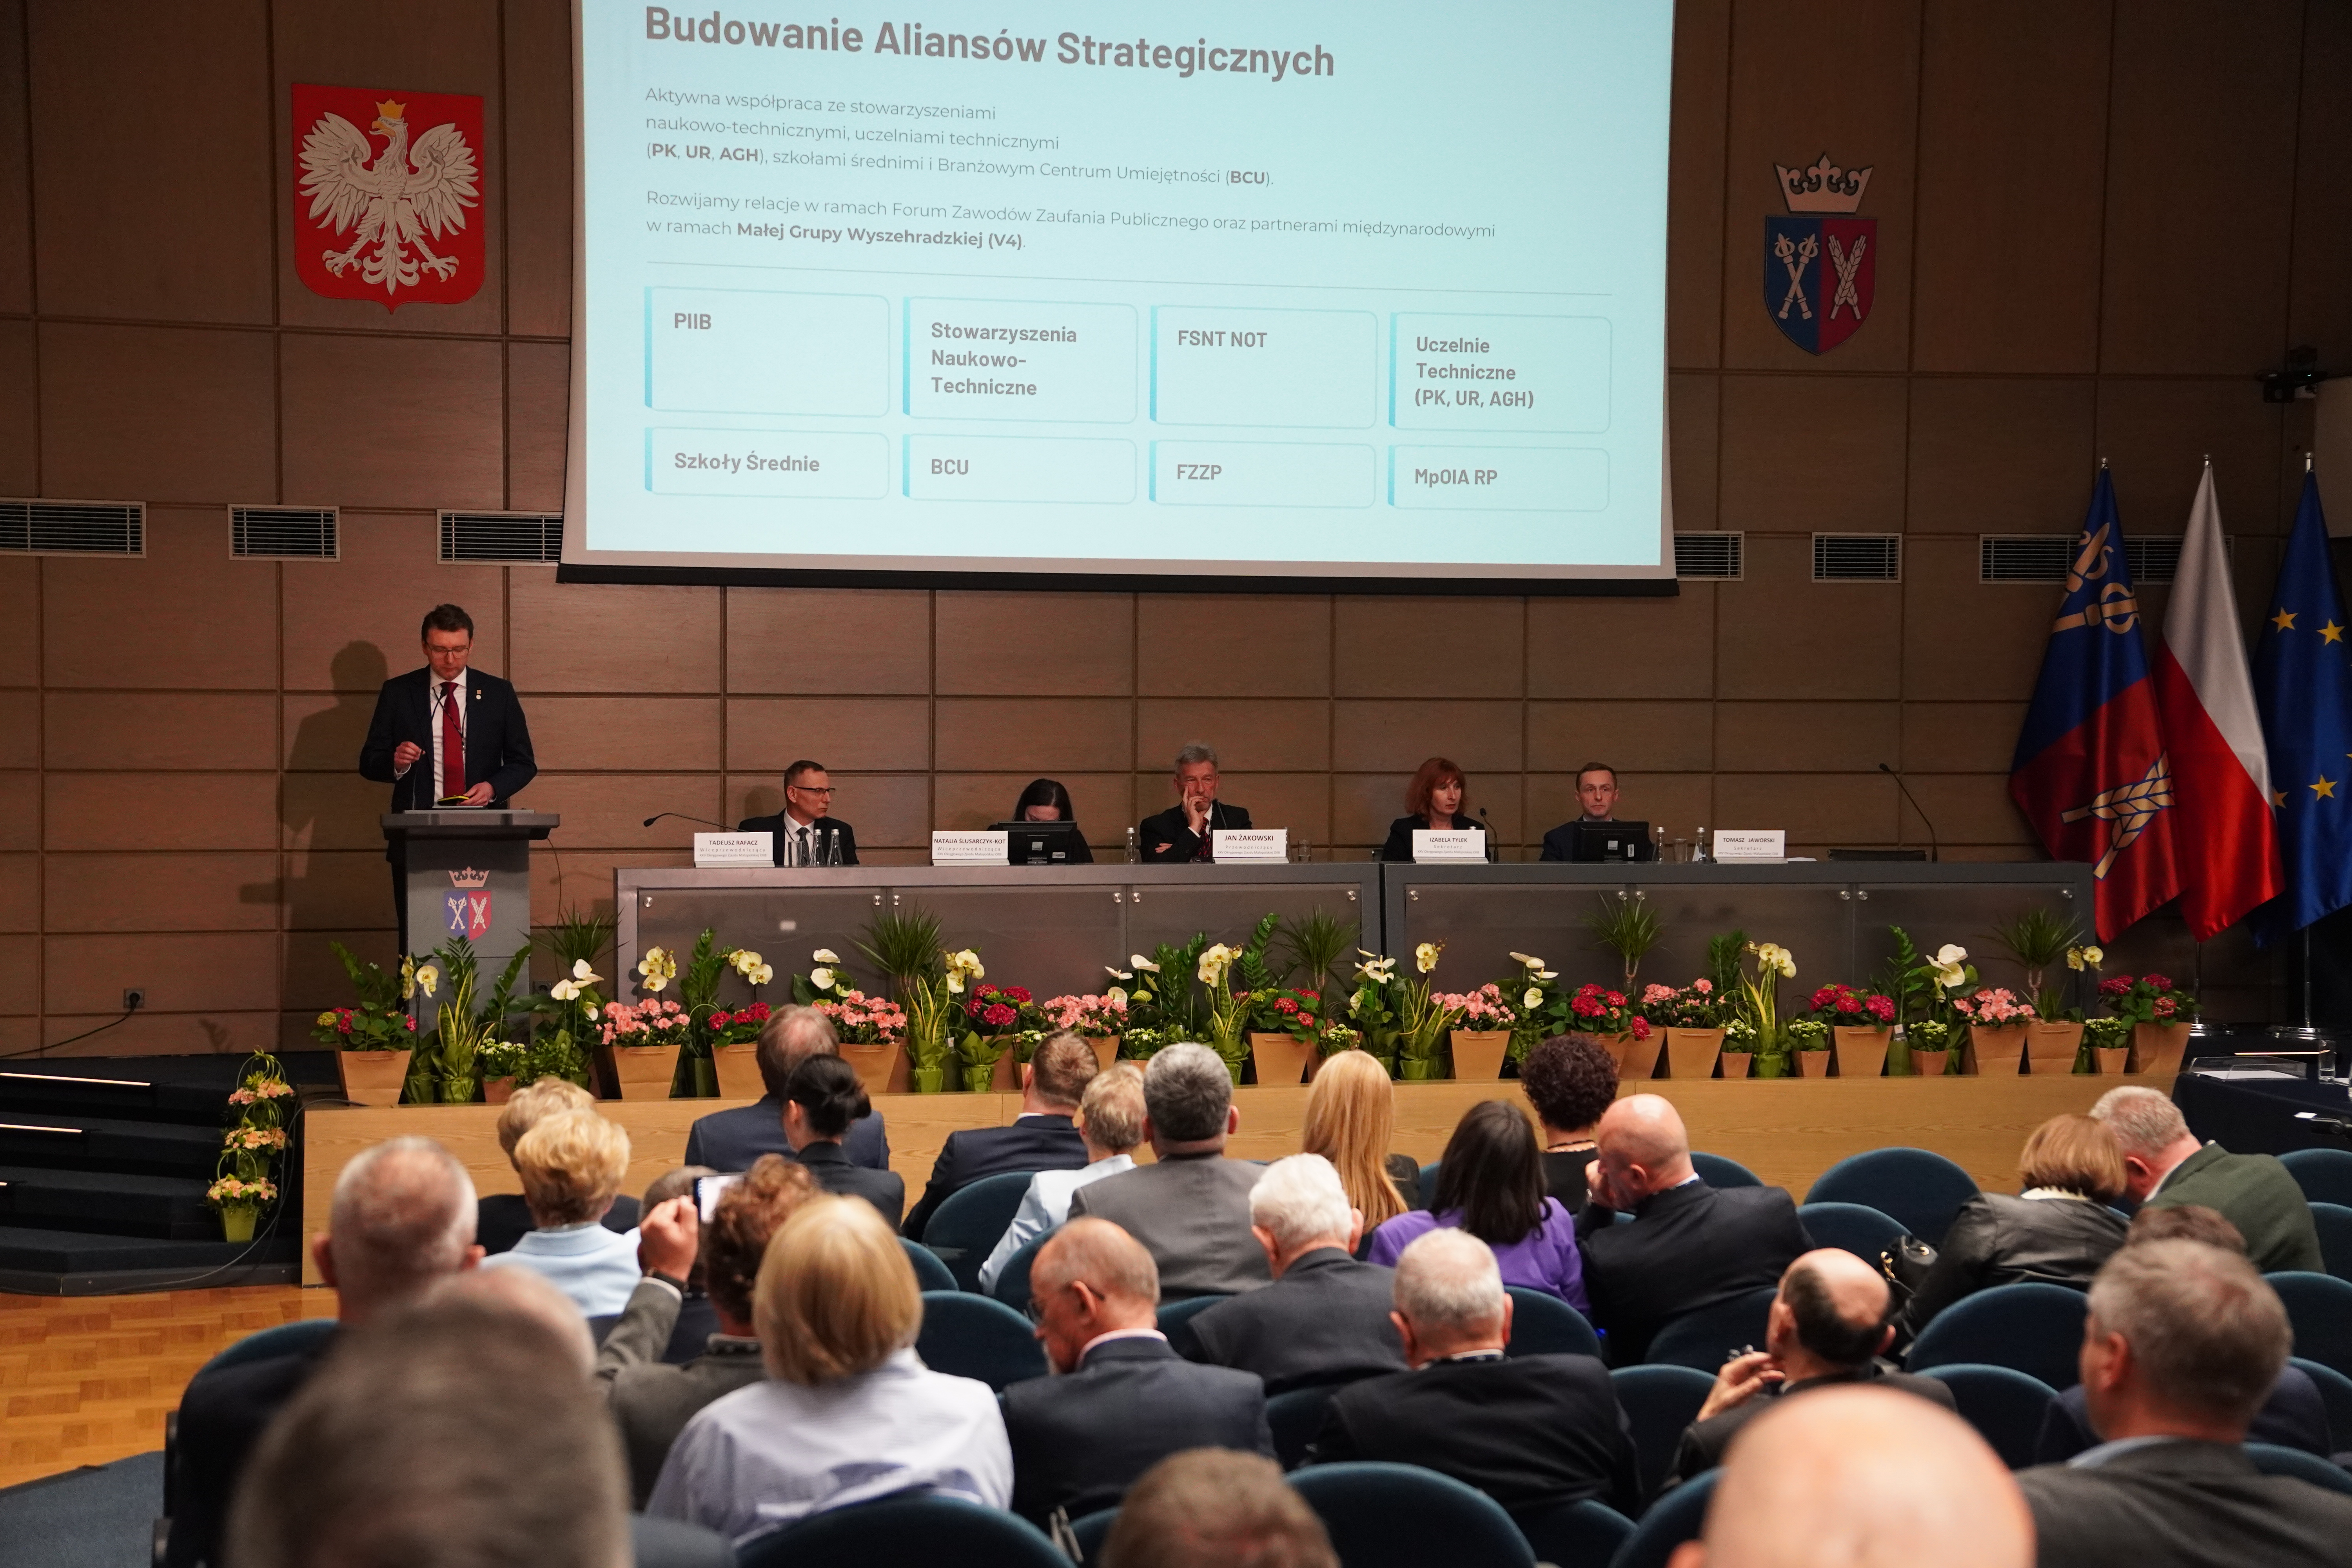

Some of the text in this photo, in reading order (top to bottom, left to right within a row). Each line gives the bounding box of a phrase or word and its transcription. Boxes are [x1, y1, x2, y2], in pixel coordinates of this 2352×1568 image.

[646, 6, 1334, 82] Budowanie Aliansów Strategicznych
[646, 88, 995, 119] Aktywna współpraca ze stowarzyszeniami
[647, 117, 1058, 151] naukowo-technicznymi, uczelniami technicznymi
[648, 143, 1273, 187] (PK, UR, AGH), szkołami średnimi i Branżowym Centrum Umiejętności (BCU).
[648, 191, 1494, 239] Rozwijamy relacje w ramach Forum Zawodów Zaufania Publicznego oraz partnerami międzynarodowymi
[647, 222, 1025, 250] w ramach Małej Grupy Wyszehradzkiej (V4).
[675, 313, 711, 329] PIIB
[932, 322, 1076, 344] Stowarzyszenia
[1179, 330, 1267, 347] FSNT NOT
[1417, 337, 1489, 353] Uczelnie
[932, 350, 1026, 367] Naukowo-
[1416, 363, 1515, 380] Techniczne
[931, 377, 1036, 395] Techniczne
[1415, 388, 1534, 408] (PK, UR, AGH)
[675, 450, 819, 474] Szkoły Średnie
[932, 459, 968, 475] BCU
[1178, 465, 1221, 480] FZZP
[1416, 469, 1497, 488] MpOIA RP
